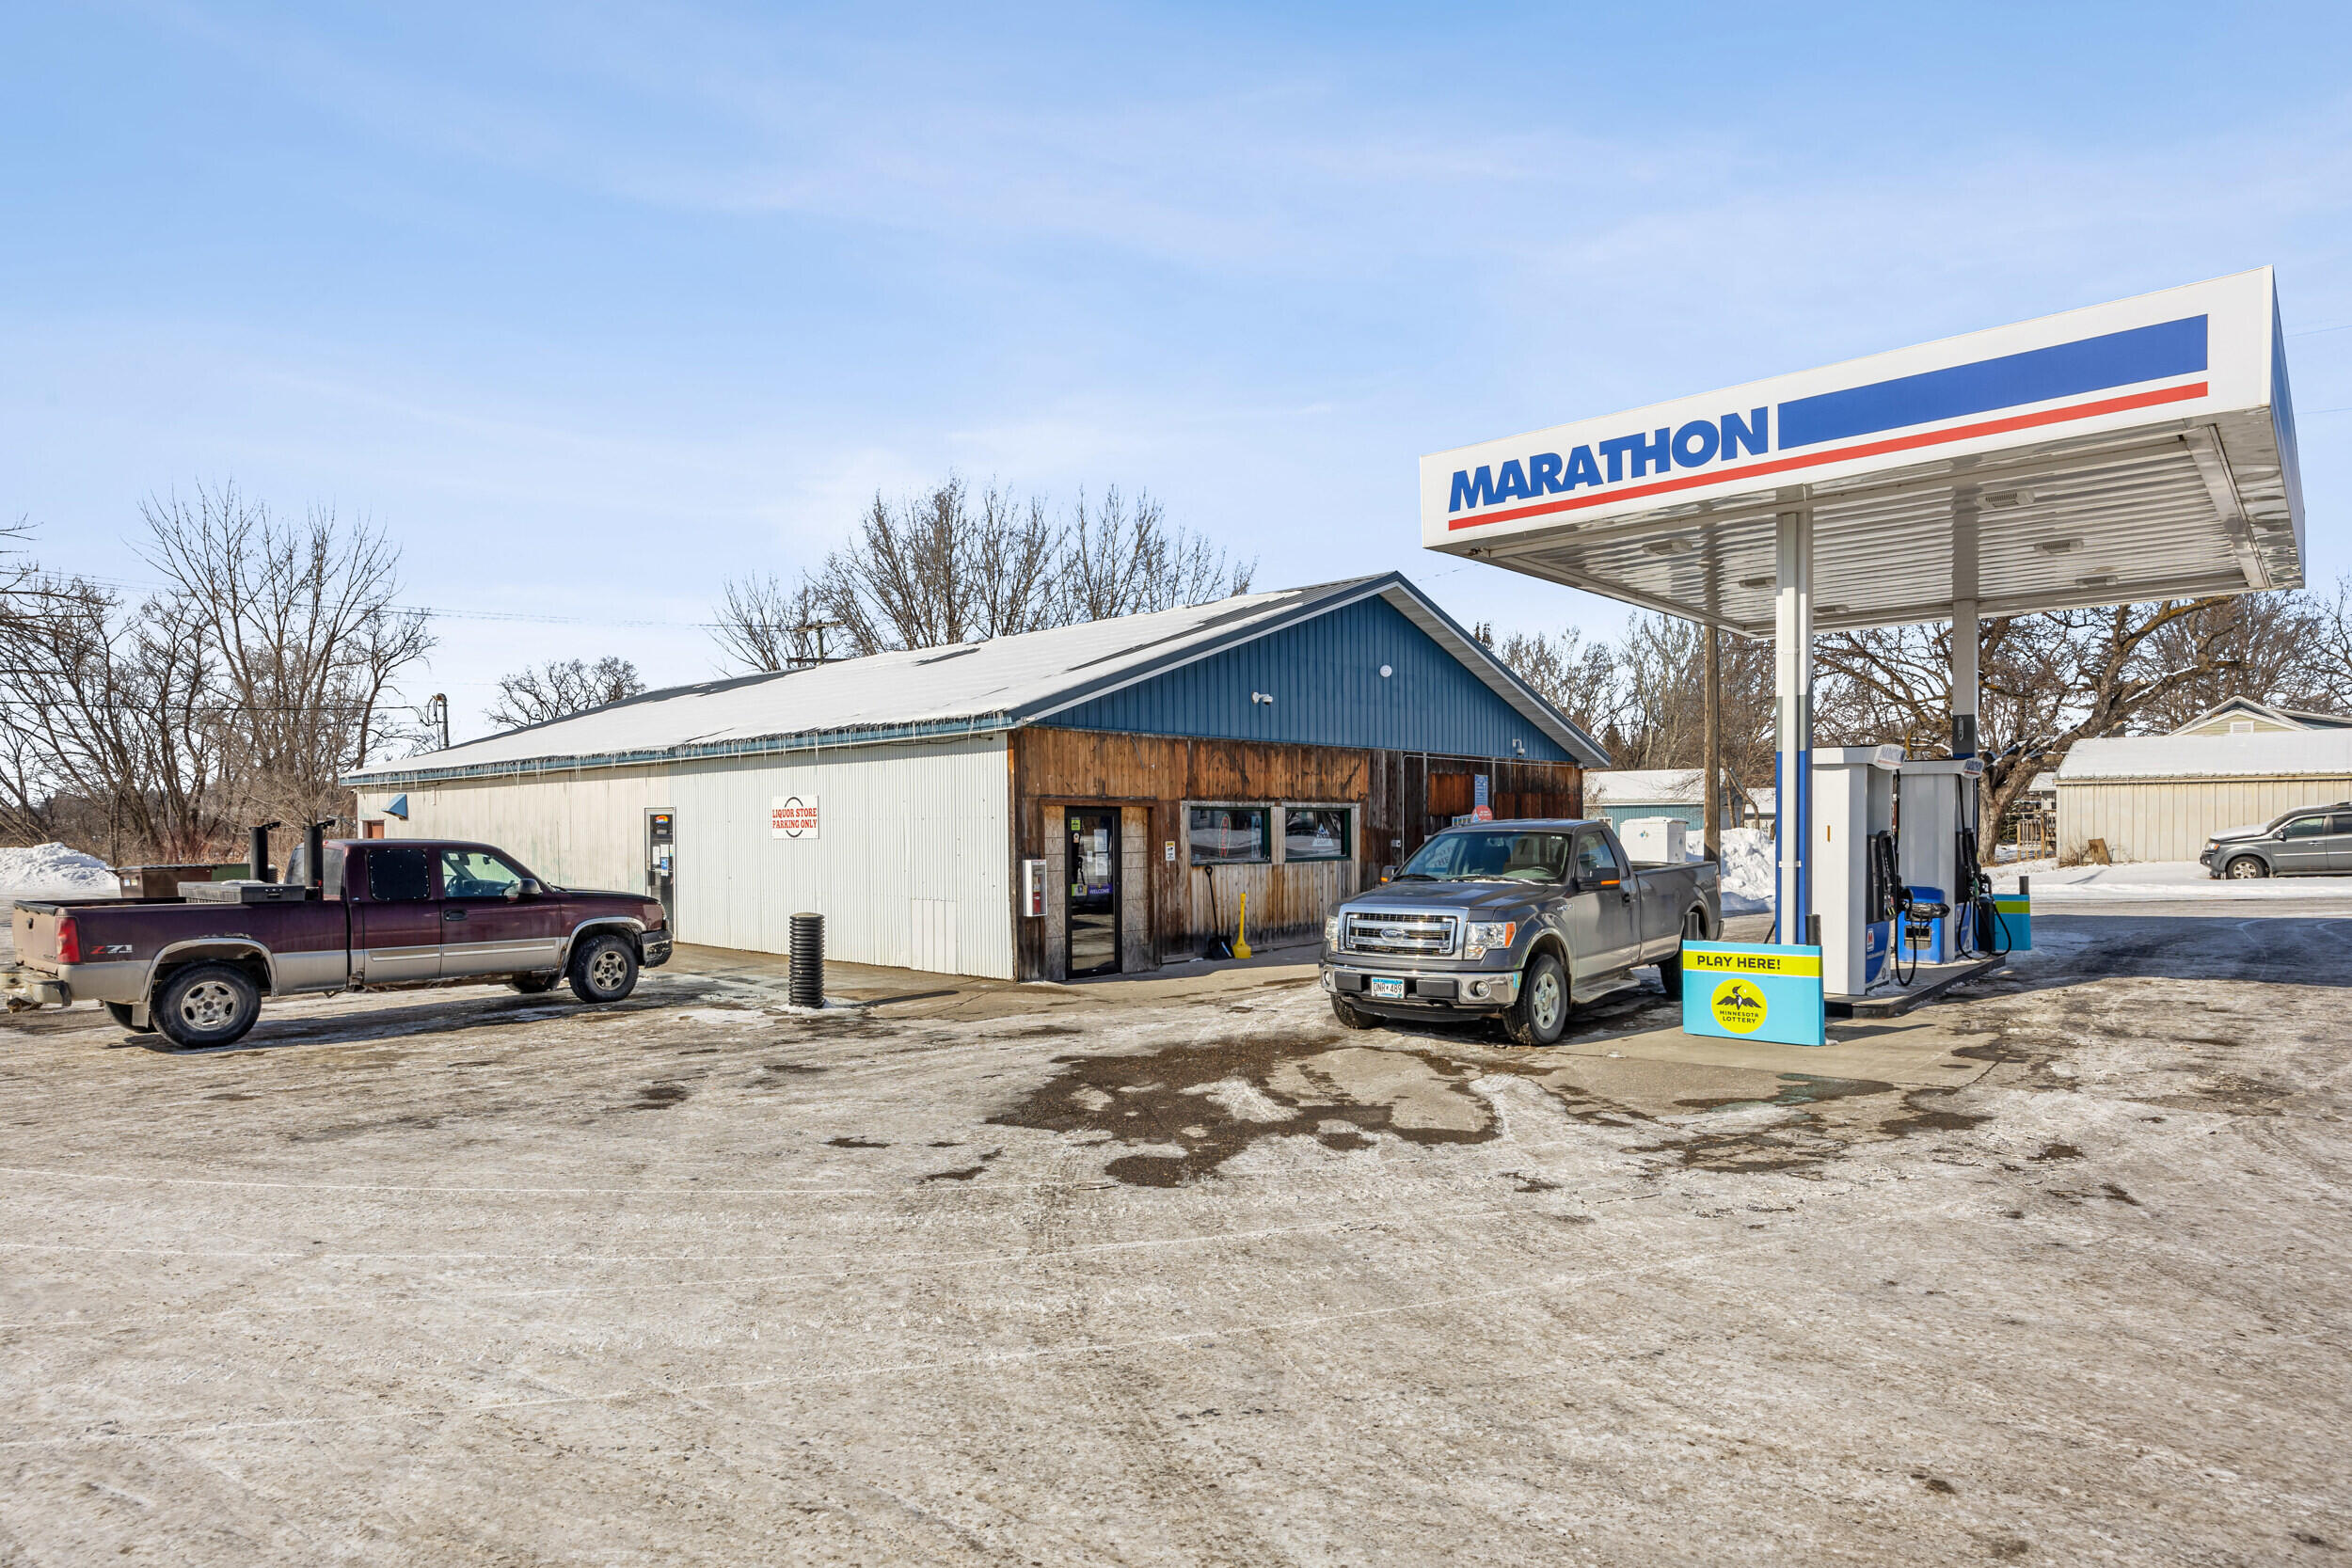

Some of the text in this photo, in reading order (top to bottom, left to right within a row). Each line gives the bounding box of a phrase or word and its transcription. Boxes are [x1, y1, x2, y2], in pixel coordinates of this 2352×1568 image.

[1449, 406, 1769, 513] MARATHON
[772, 808, 817, 818] LIQUOR STORE
[801, 819, 817, 828] ONLY
[90, 944, 134, 955] Z71
[1697, 956, 1781, 970] PLAY HERE!
